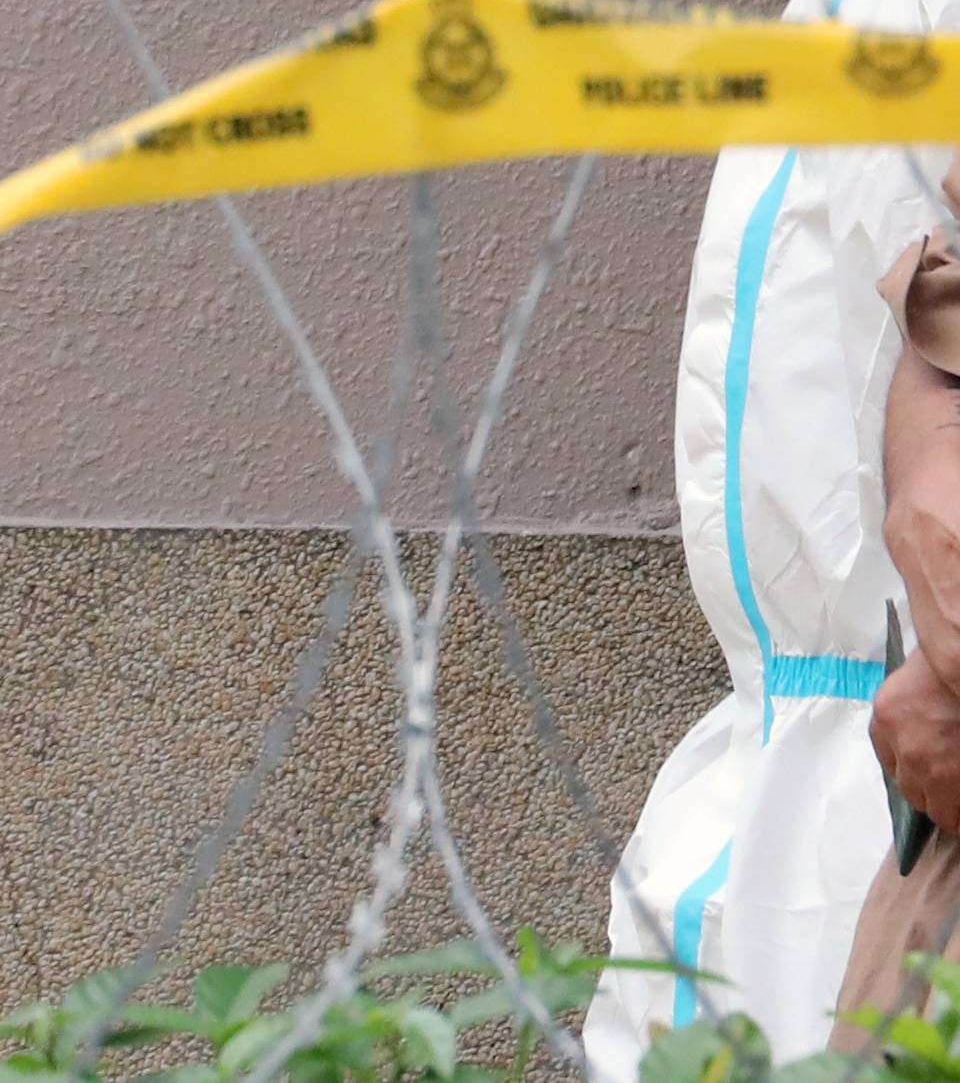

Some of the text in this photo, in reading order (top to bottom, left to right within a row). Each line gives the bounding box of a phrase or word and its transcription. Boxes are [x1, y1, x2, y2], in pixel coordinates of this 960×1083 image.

[582, 70, 768, 107] POLICE LINE
[206, 106, 309, 147] CROSS
